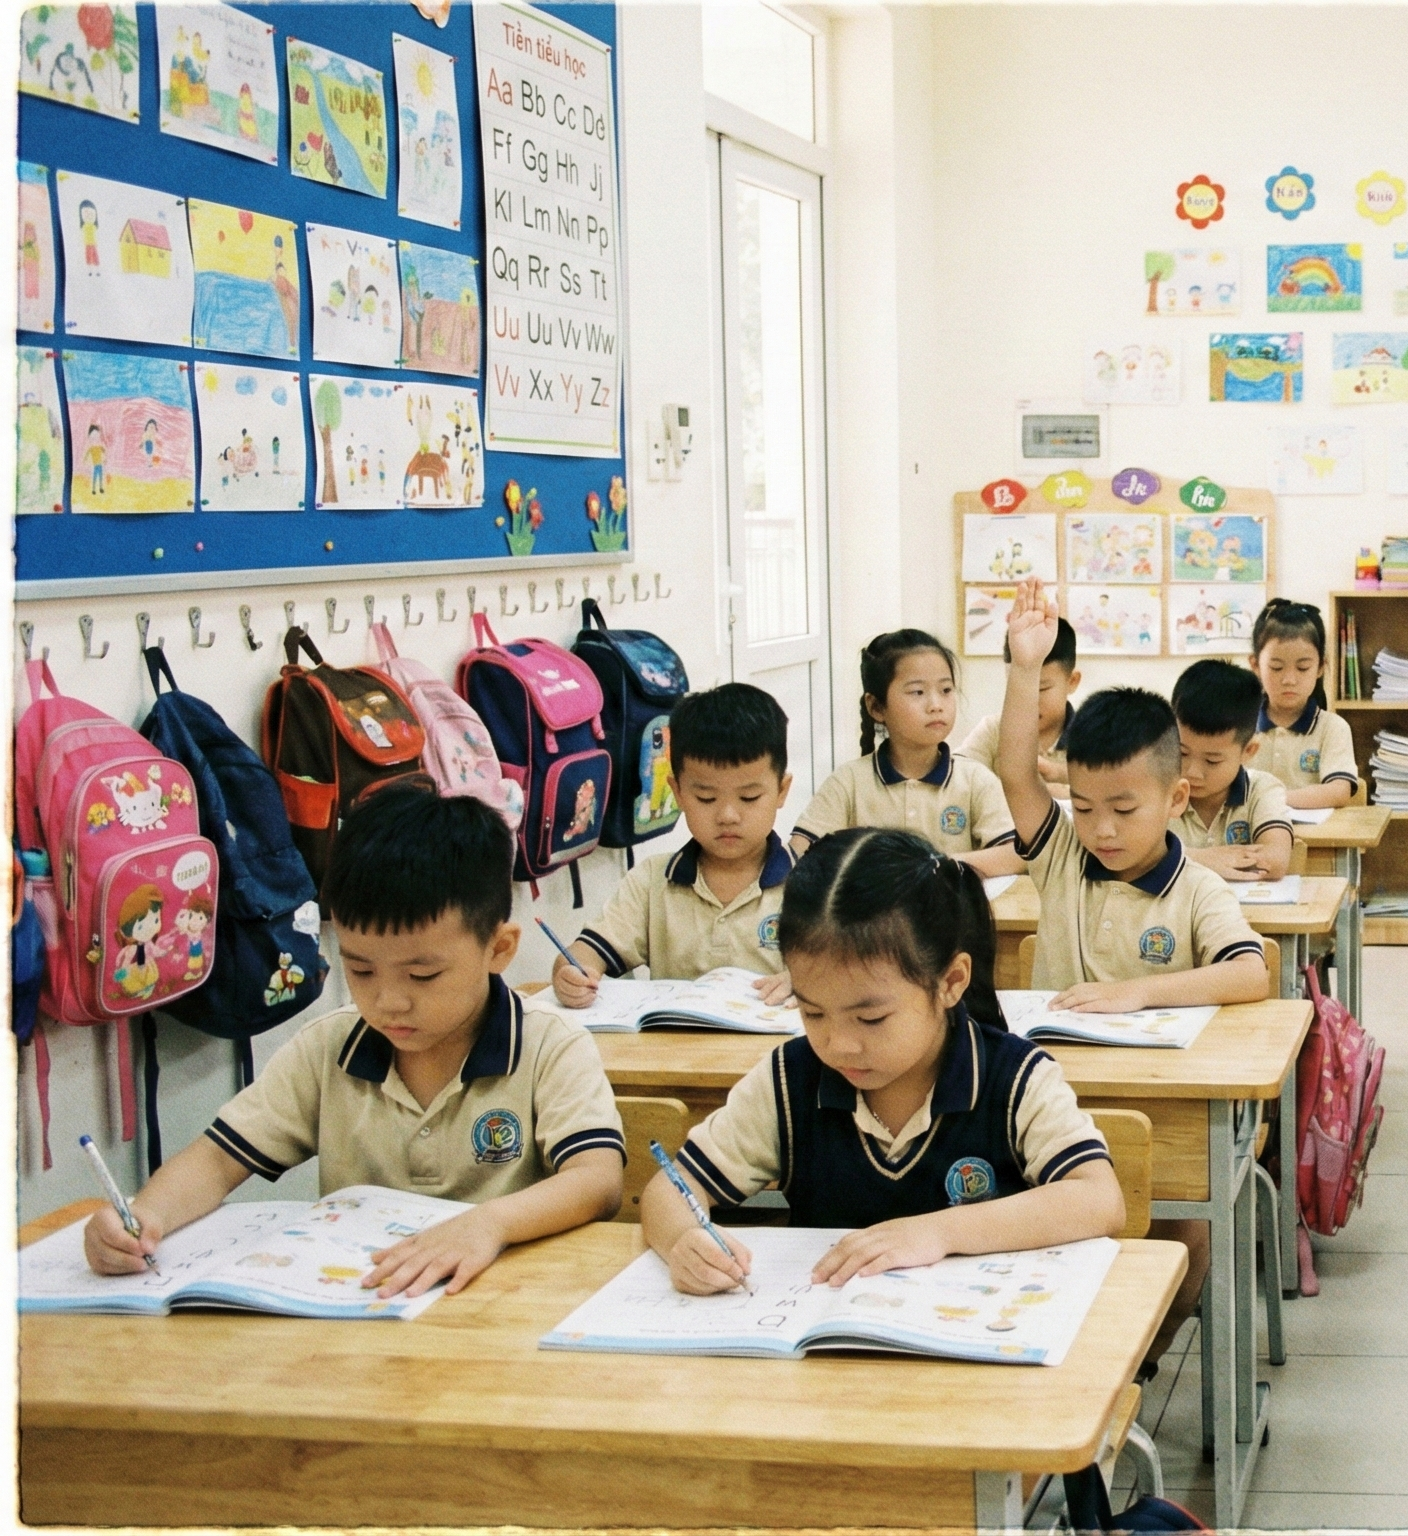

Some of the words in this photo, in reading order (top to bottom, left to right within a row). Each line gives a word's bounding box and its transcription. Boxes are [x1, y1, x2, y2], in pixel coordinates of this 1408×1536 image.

[564, 49, 586, 80] học
[487, 67, 514, 106] Aa
[521, 79, 546, 118] Bb
[553, 93, 577, 130] Cc
[492, 127, 512, 164] Ff
[522, 139, 548, 183] Gg
[556, 149, 579, 187] Hh
[589, 162, 603, 202] Jj
[522, 196, 551, 233] Lm
[557, 205, 580, 240] Nn
[587, 215, 609, 256] Pp
[492, 246, 520, 291] Qq
[528, 254, 550, 289] Rr
[560, 262, 582, 296] Ss
[590, 269, 607, 301] Tt
[493, 305, 520, 341] Uu
[527, 311, 553, 346] Uu
[558, 317, 581, 350] Vv
[585, 322, 615, 355] Ww
[494, 363, 520, 397] Vv
[529, 368, 553, 401] Xx
[560, 372, 583, 414] Yy
[590, 377, 610, 408] Zz
